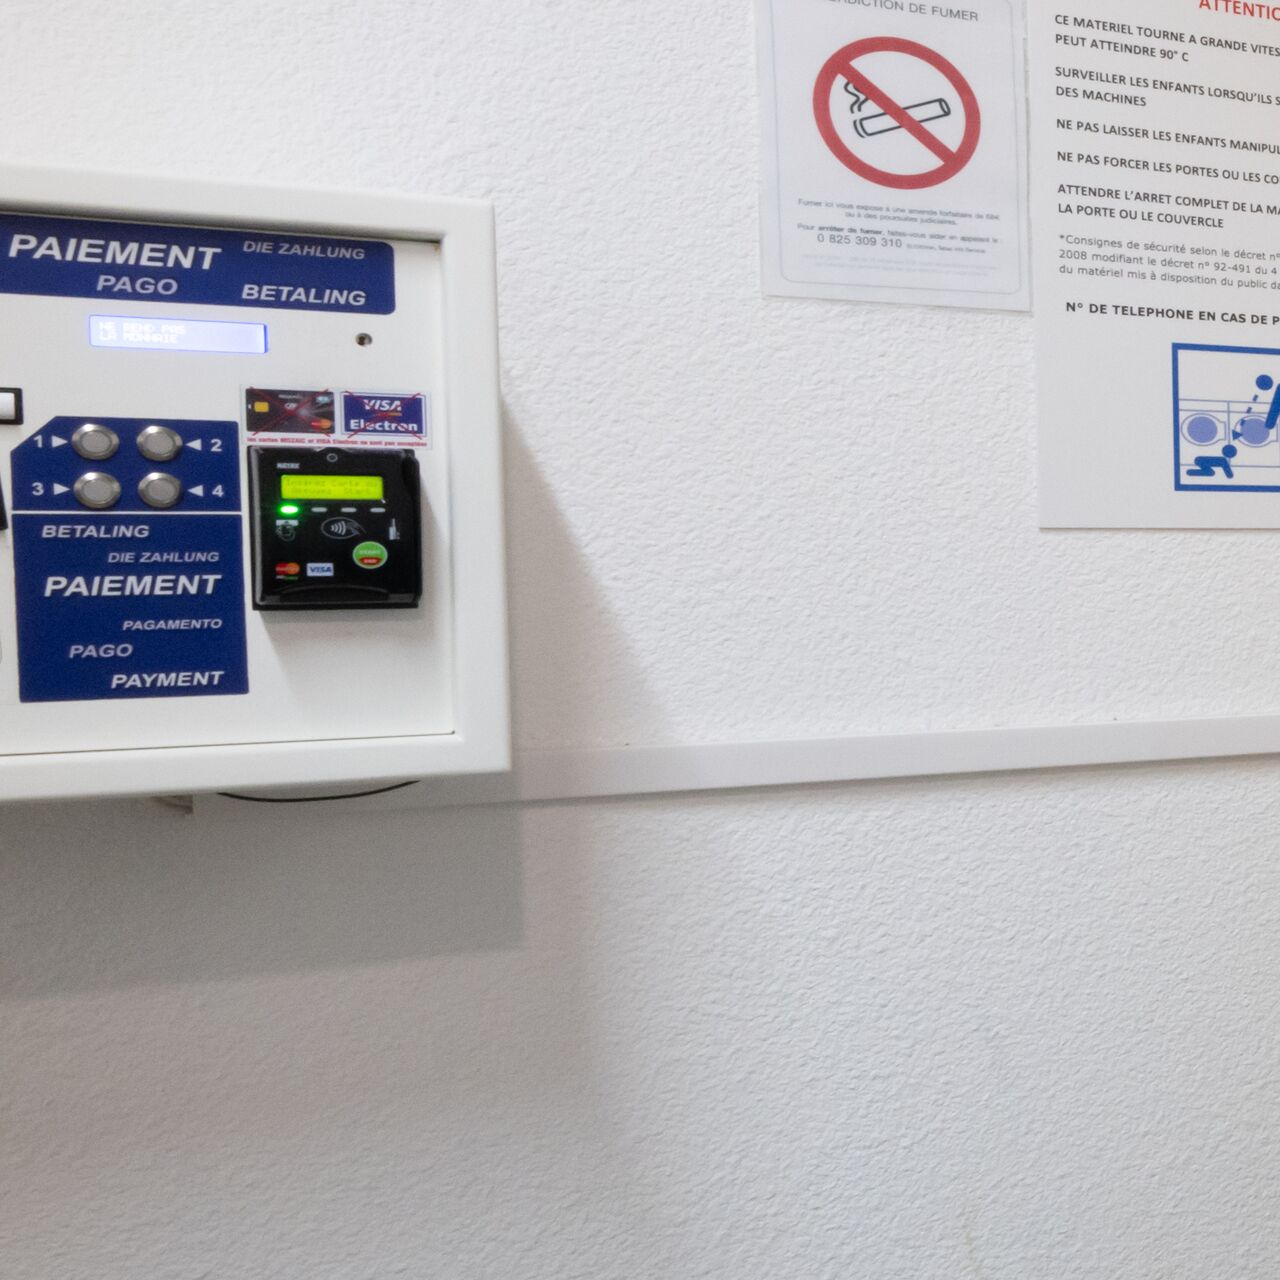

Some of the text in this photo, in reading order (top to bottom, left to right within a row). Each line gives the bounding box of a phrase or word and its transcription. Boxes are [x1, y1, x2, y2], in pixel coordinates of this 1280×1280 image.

[909, 3, 926, 14] DE
[931, 6, 979, 21] FUMER
[1054, 14, 1068, 25] CE
[1073, 16, 1133, 35] MATERIEL
[1136, 26, 1185, 43] TOURNE
[1188, 34, 1196, 44] A
[1200, 36, 1247, 52] GRANDE
[1055, 33, 1188, 62] PEUT ATTEINDRE 90° C
[1056, 118, 1072, 130] NE
[1076, 121, 1099, 133] PAS
[1103, 124, 1149, 138] LAISSER
[1152, 130, 1171, 141] LES
[1175, 132, 1226, 148] ENFANTS
[817, 233, 902, 248] 0 825 309 310
[8, 233, 222, 270] PAIEMENT
[243, 240, 366, 261] DIE ZAHLUNG
[1126, 240, 1140, 250] de
[1143, 241, 1186, 254] sécurité
[1190, 246, 1217, 256] selon
[1221, 248, 1230, 257] le
[1233, 249, 1266, 260] décret
[1269, 252, 1280, 261] n°
[97, 274, 178, 296] PAGO
[242, 284, 366, 307] BETALING
[1066, 302, 1083, 312] N°
[1089, 303, 1107, 314] DE
[1112, 305, 1193, 320] TELEPHONE
[1198, 311, 1215, 321] EN
[1220, 312, 1246, 323] CAS
[1251, 314, 1267, 325] DE
[364, 400, 402, 411] VISA
[350, 419, 418, 432] Electron
[33, 435, 43, 448] 1
[210, 439, 222, 452] 2
[31, 482, 44, 496] 3
[211, 485, 224, 497] 4
[42, 525, 150, 538] BETALING
[108, 551, 220, 563] DIE ZAHLUNG
[44, 575, 222, 597] PAIEMENT
[123, 619, 222, 631] PAGAMENTO
[69, 644, 133, 658] PAGO
[111, 672, 224, 689] PAYMENT
